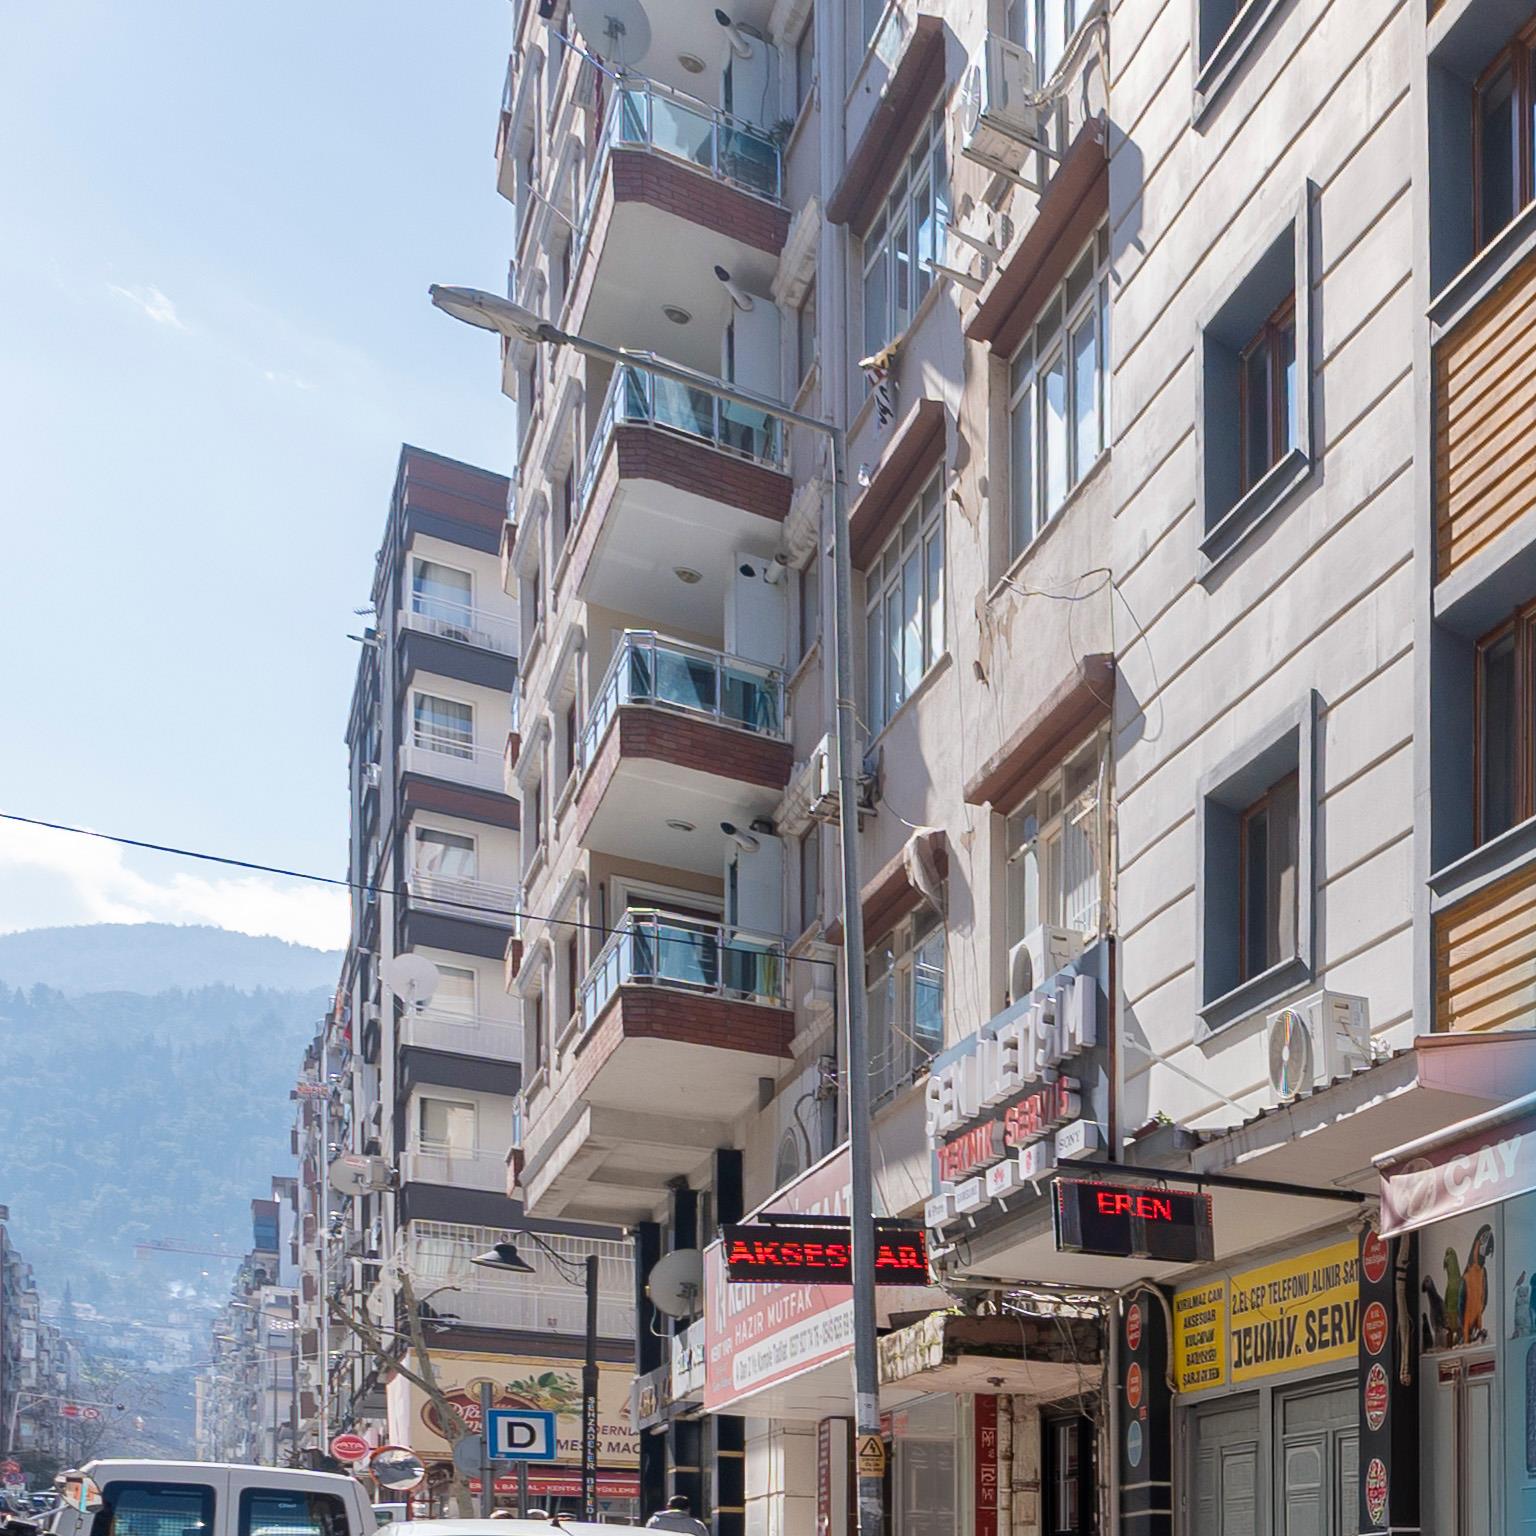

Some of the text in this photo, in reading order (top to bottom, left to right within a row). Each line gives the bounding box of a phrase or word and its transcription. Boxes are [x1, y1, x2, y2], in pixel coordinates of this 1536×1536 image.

[1444, 1133, 1523, 1206] ÇAY
[1097, 1192, 1171, 1221] EREN
[728, 1241, 923, 1268] AKSESAR
[1251, 1287, 1265, 1310] CEP
[1268, 1271, 1310, 1304] TELEFONU
[735, 1308, 764, 1344] HAZIR
[768, 1287, 813, 1325] MUTFAK
[507, 1421, 536, 1449] D
[556, 1438, 601, 1452] MESR
